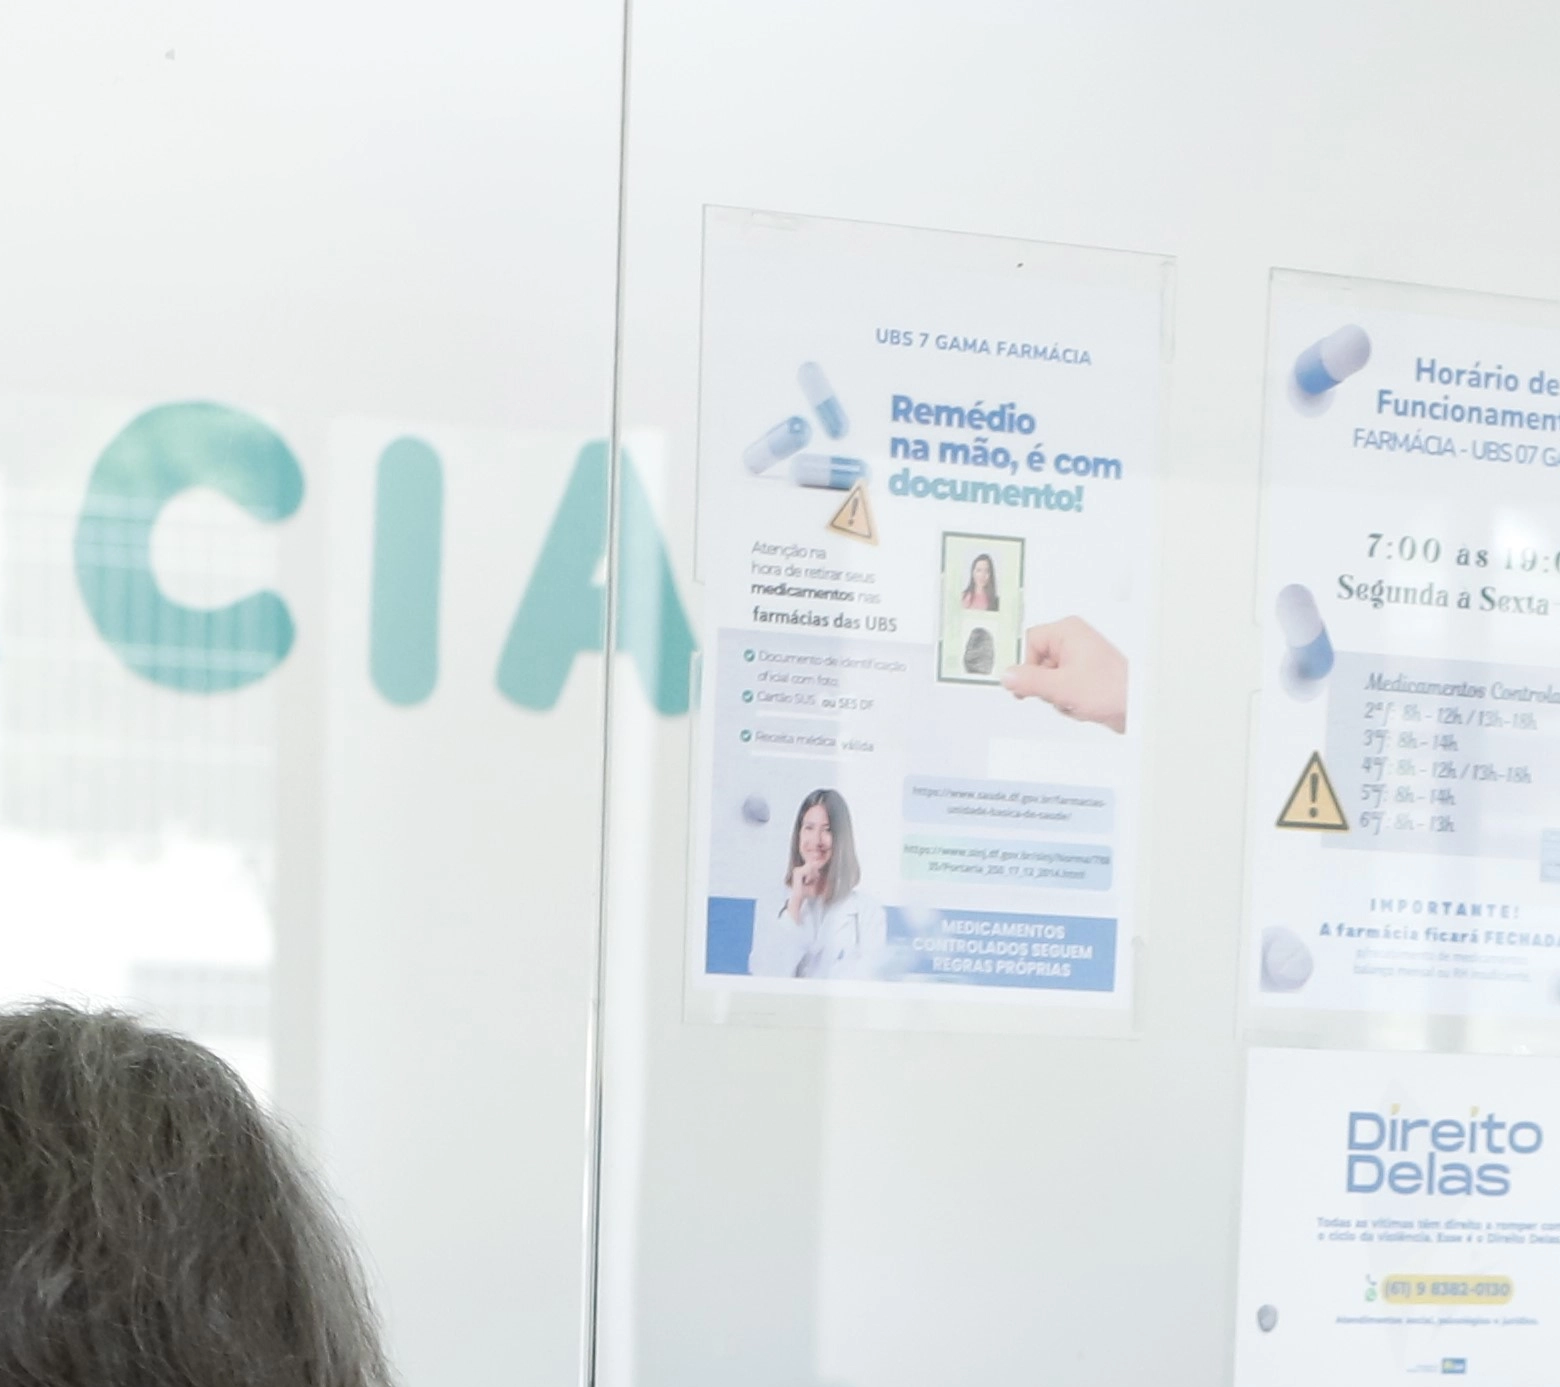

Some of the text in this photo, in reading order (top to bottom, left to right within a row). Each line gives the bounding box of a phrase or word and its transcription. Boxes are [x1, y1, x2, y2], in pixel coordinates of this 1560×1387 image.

[875, 327, 1092, 365] UBS 7 GAMA FARMÁCIA
[1415, 357, 1560, 397] Horário de
[891, 395, 1037, 434] Remédio
[890, 436, 1123, 480] na mão, é com
[1352, 427, 1458, 457] FARMÁCIA
[1471, 439, 1512, 463] UBS
[1517, 444, 1538, 464] 07
[889, 467, 1085, 512] documento!
[751, 541, 827, 560] Atenção na
[1366, 532, 1443, 564] 7:00
[751, 561, 781, 576] hora
[784, 564, 802, 578] de
[750, 583, 855, 602] medicamentos
[1336, 573, 1450, 609] Segunda
[752, 605, 898, 632] farmácias das UBS
[1363, 672, 1486, 699] Medicamentos
[1370, 897, 1520, 920] IMPORTANTE!
[942, 919, 1066, 939] MEDICAMENTOS
[1318, 921, 1332, 937] A
[1335, 923, 1419, 942] farmácia
[1423, 927, 1479, 944] ficará
[912, 936, 1093, 960] CONTROLADOS SEGUEM
[932, 956, 1072, 977] REGRAS PRÓPRIAS
[1347, 1103, 1544, 1154] Direito
[1346, 1152, 1511, 1197] Delas
